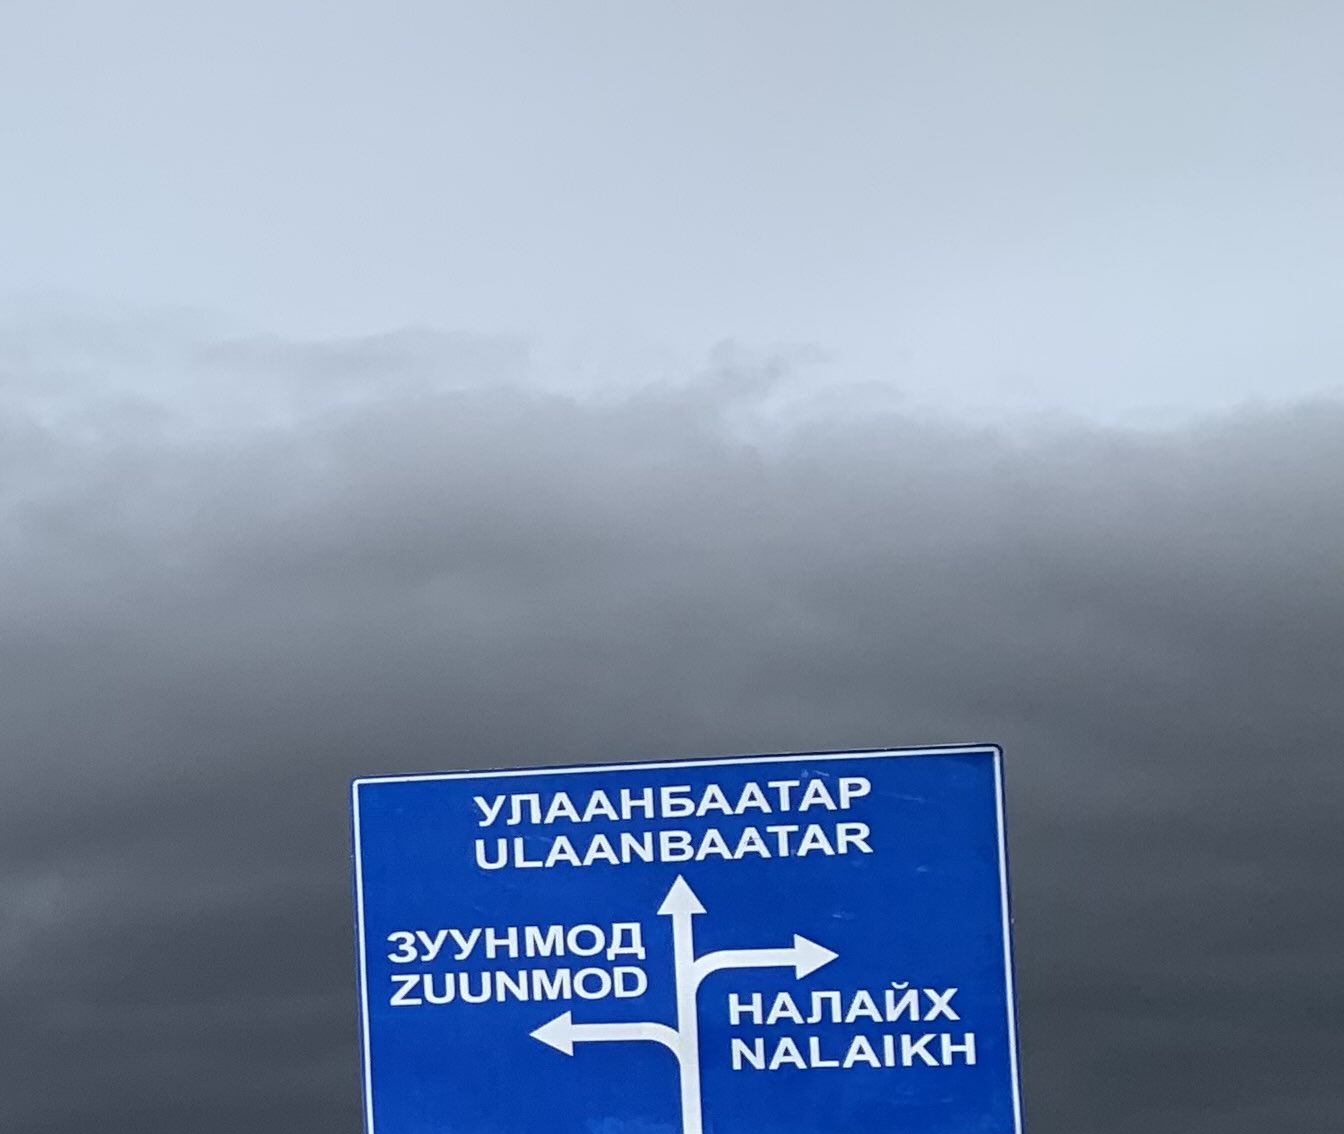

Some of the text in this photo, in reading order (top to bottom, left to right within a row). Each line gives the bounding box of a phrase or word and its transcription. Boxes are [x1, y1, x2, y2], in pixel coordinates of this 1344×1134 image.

[473, 777, 871, 827] УЛААНБААТАР
[475, 822, 874, 870] ULAANBAATAR
[387, 922, 646, 964] ЗУУНМОД
[389, 966, 648, 1006] ZUUNMOD
[728, 981, 961, 1025] НАЛАЙХ
[731, 1032, 976, 1070] NALAIKH
